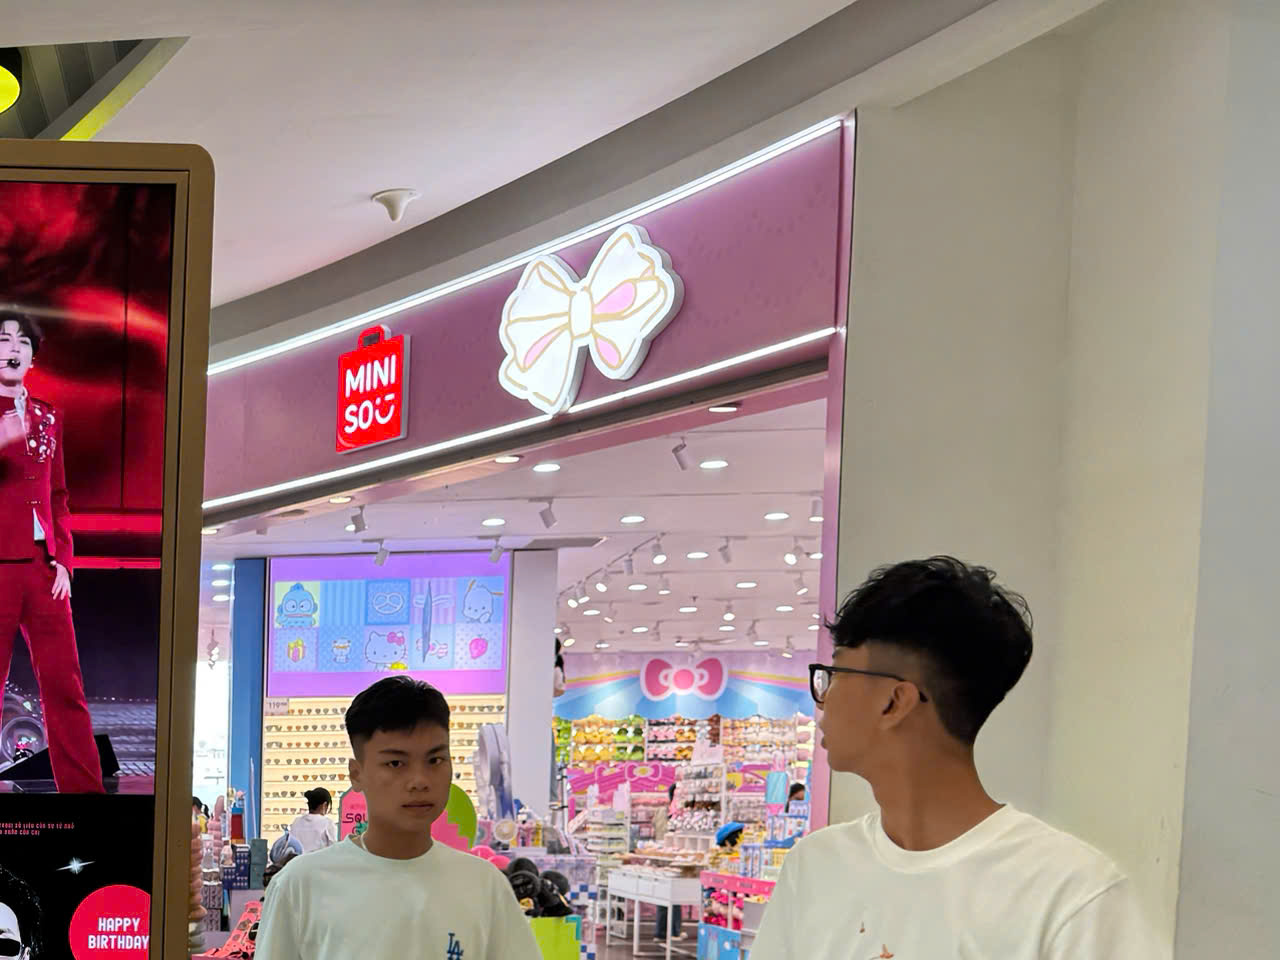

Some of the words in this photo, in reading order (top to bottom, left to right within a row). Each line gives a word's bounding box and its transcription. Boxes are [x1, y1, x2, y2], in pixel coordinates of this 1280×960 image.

[345, 354, 397, 398] MINI
[98, 917, 141, 932] HAPPY
[87, 935, 150, 950] BIRTHDAY
